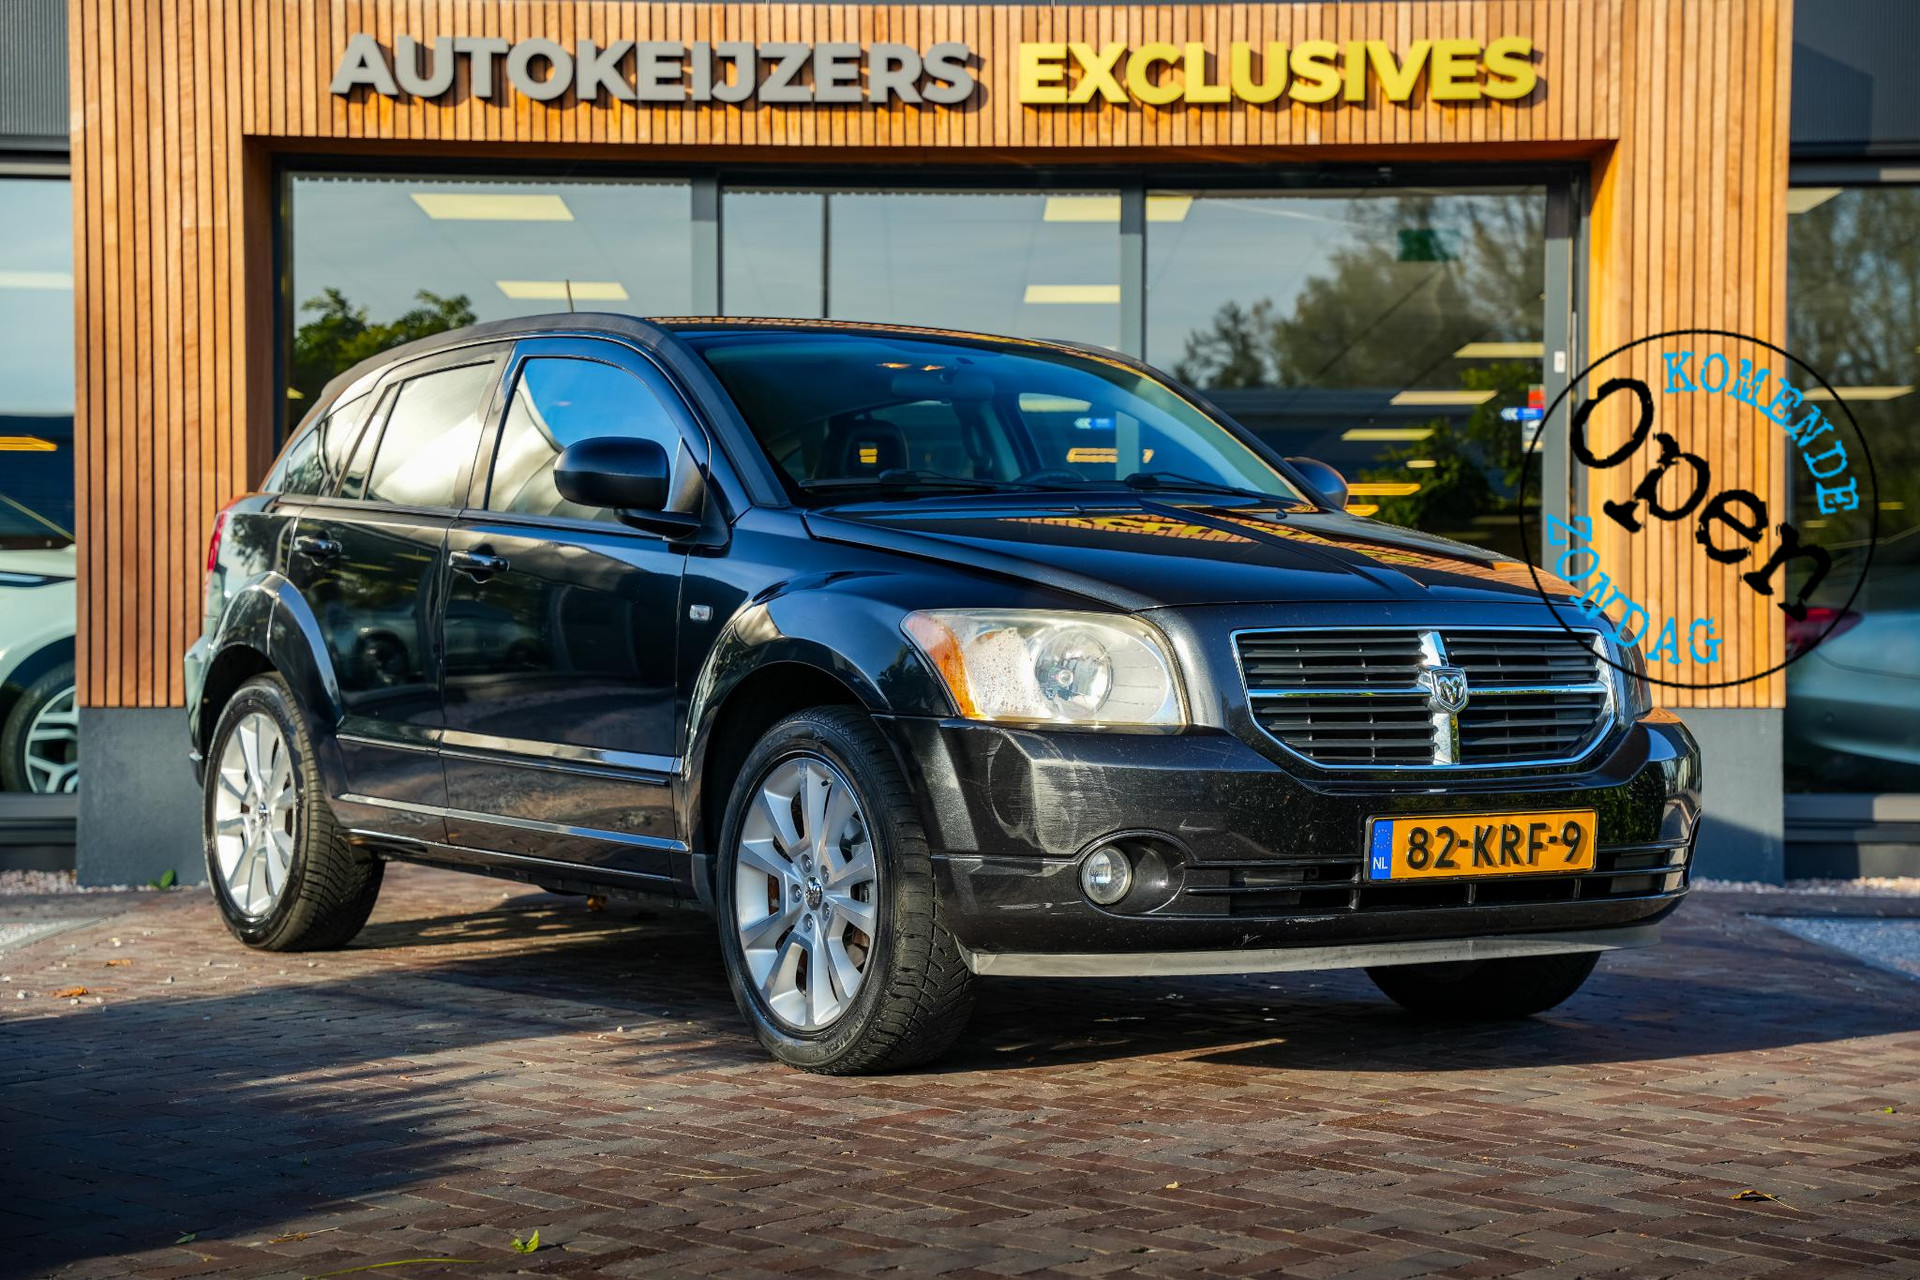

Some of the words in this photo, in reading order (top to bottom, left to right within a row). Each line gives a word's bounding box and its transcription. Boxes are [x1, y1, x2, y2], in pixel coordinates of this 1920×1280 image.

[330, 33, 976, 104] AUTOKEIJZERS
[1018, 37, 1538, 104] EXCLUSIVES
[1372, 856, 1388, 870] NL
[1406, 820, 1582, 870] 82-KRF-9
